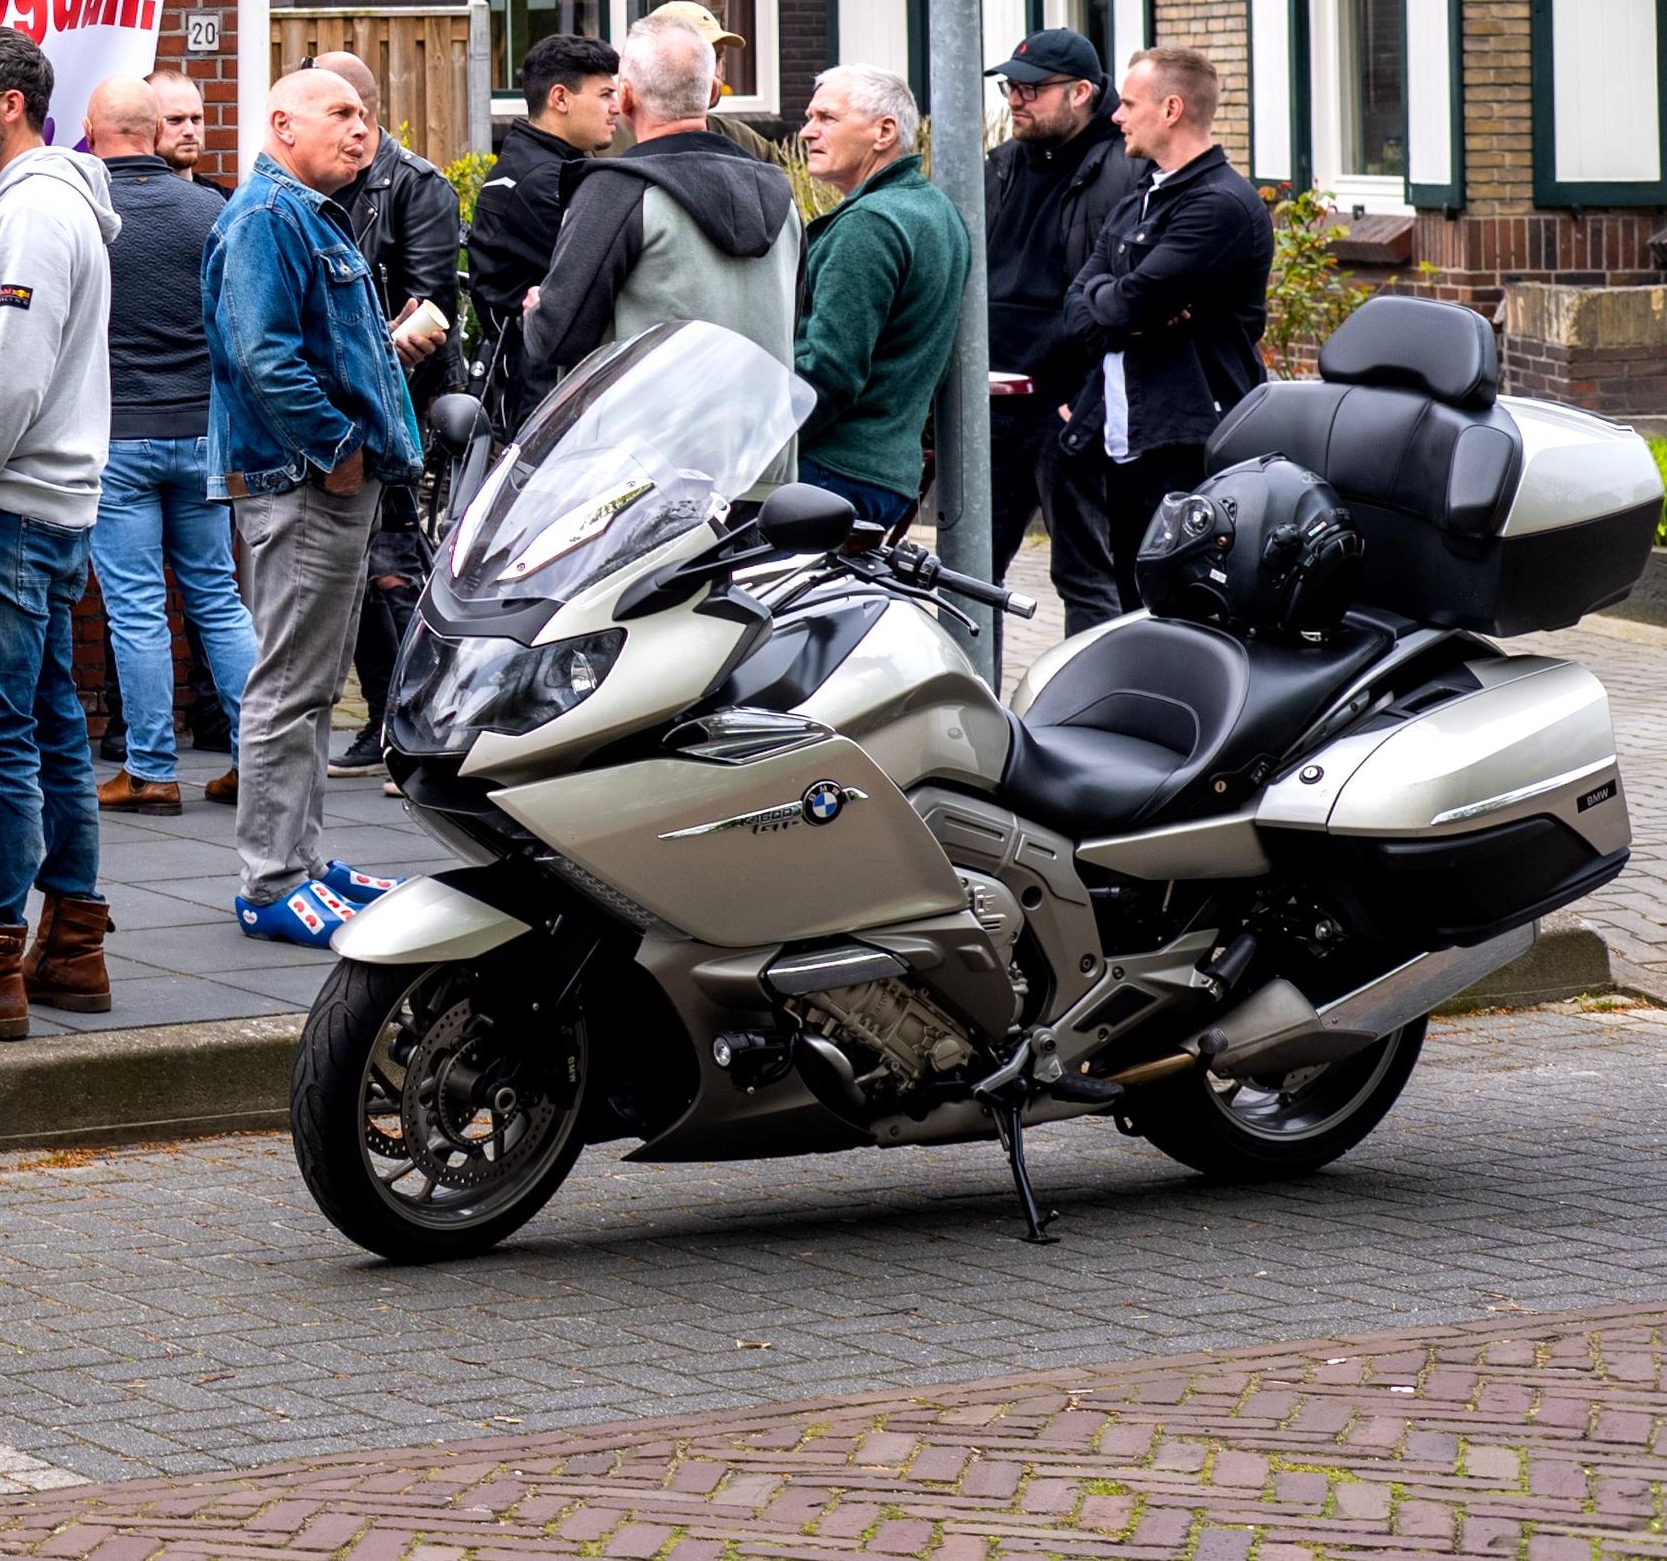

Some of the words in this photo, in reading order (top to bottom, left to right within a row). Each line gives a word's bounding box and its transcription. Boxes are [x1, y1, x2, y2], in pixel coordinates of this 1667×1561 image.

[193, 22, 216, 45] 20
[807, 784, 841, 802] BMW
[1587, 787, 1609, 806] BMW
